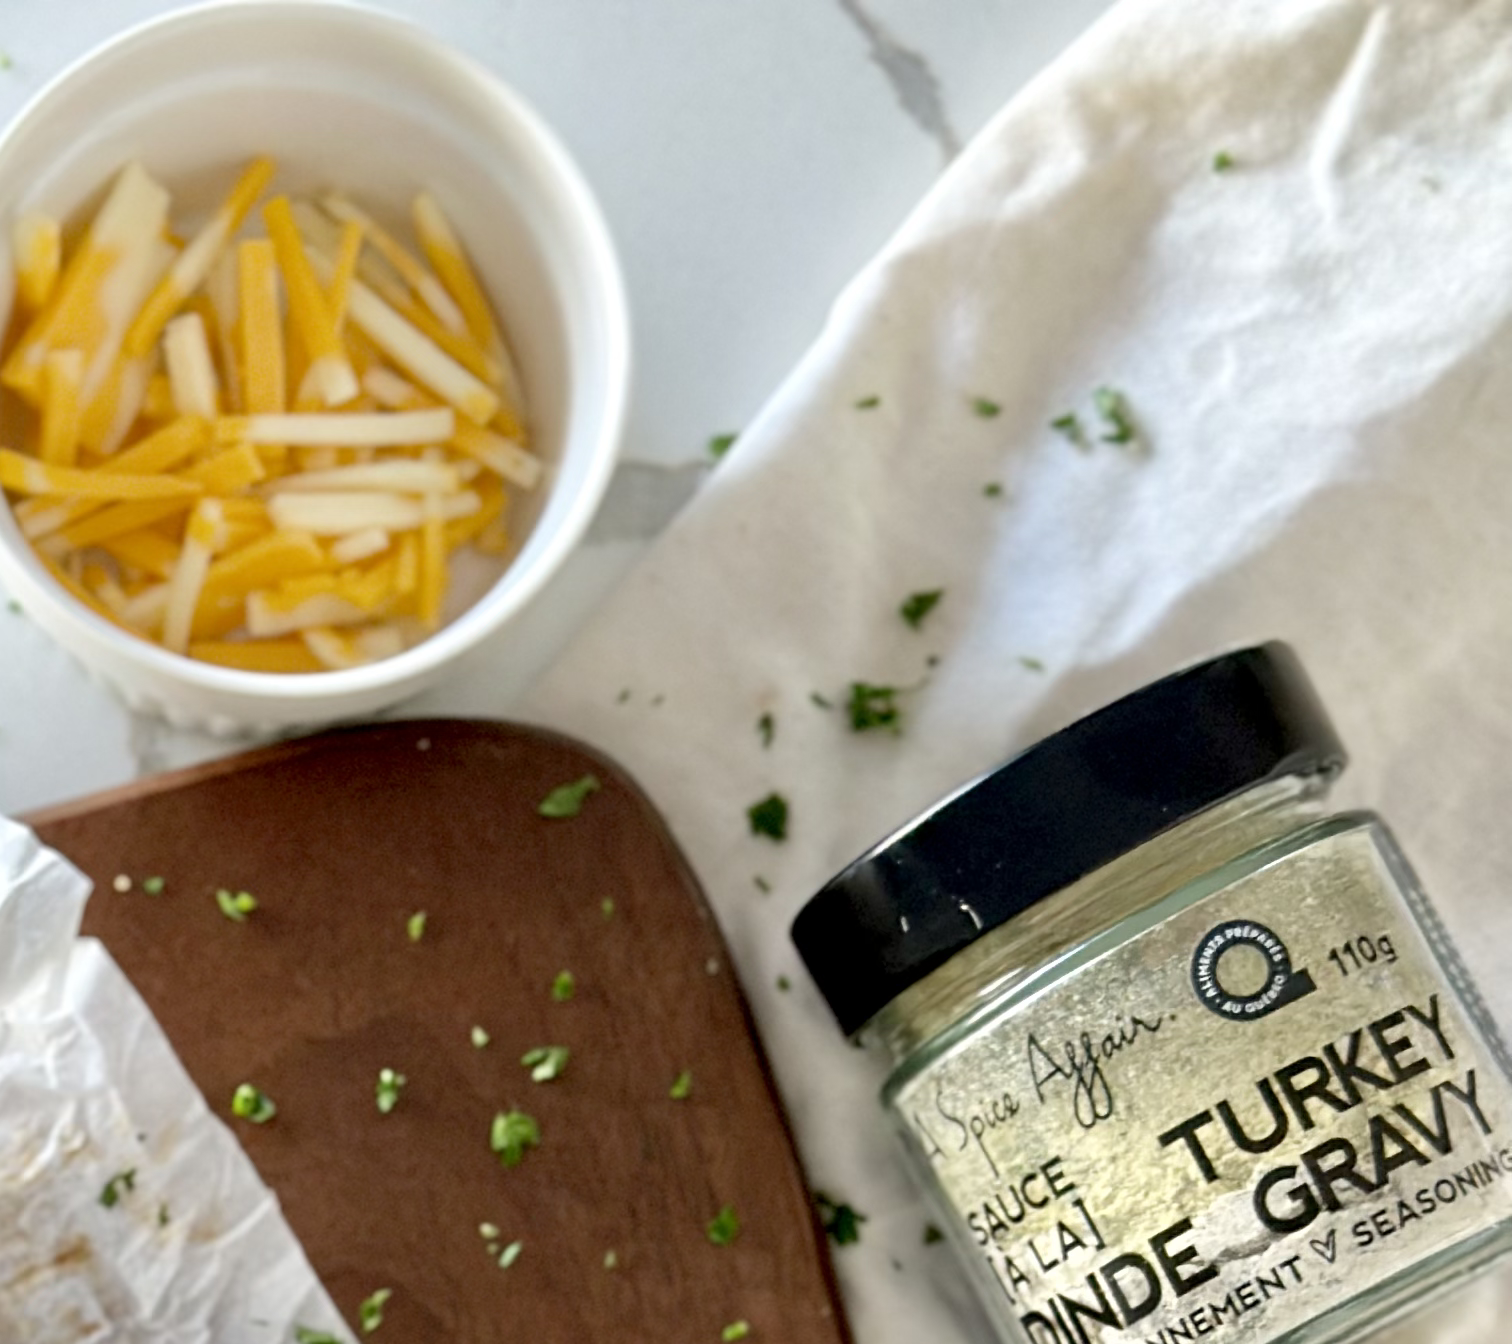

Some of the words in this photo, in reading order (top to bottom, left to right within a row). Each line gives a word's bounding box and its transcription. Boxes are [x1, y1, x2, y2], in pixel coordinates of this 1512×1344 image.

[1197, 934, 1226, 998] ALIMENTS
[1327, 934, 1399, 977] 110g
[1221, 1001, 1243, 1014] AU
[936, 1086, 1020, 1179] Spice
[1157, 993, 1456, 1185] TURKEY
[1252, 1068, 1493, 1234] GRAVY
[967, 1155, 1077, 1247] SAUCE
[1027, 1197, 1106, 1274] LA]
[1352, 1149, 1512, 1248] SEASONING
